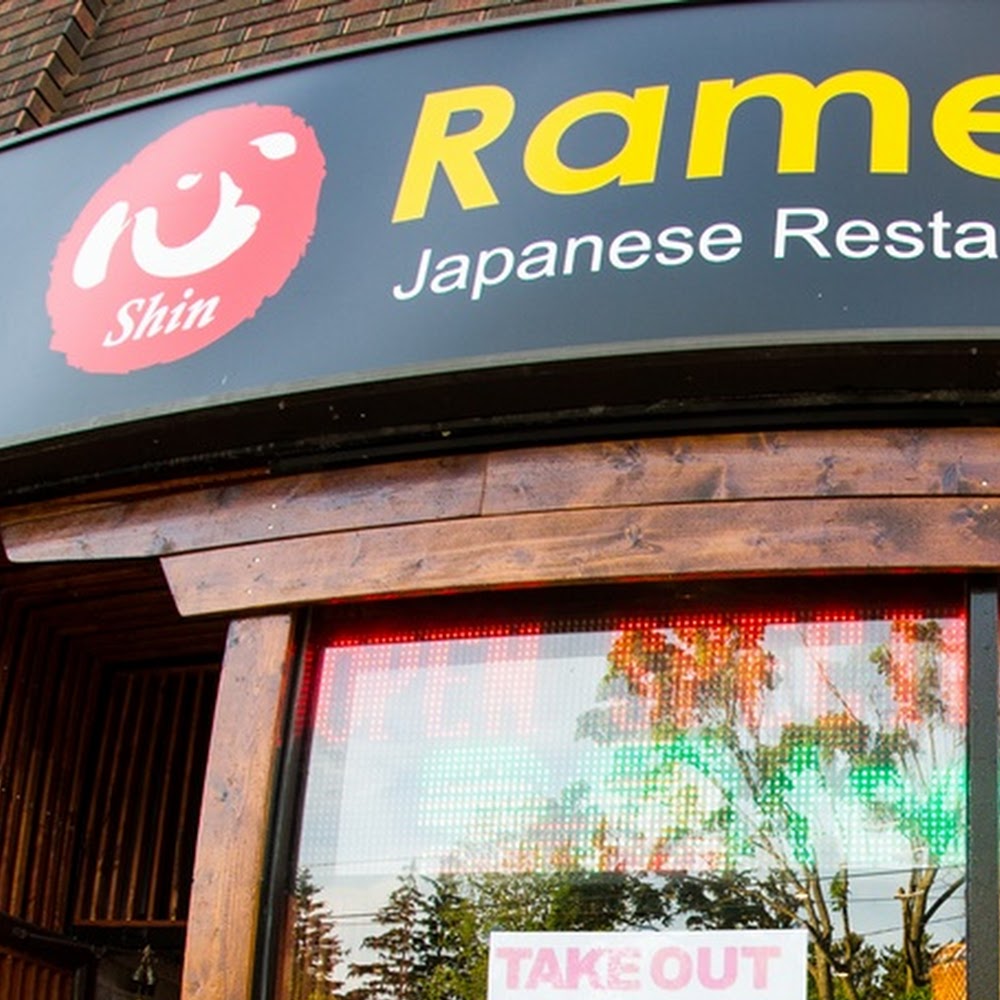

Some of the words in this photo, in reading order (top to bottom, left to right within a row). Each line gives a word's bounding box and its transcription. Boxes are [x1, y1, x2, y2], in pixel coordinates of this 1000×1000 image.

[392, 219, 743, 301] Japanese
[102, 287, 221, 348] Shin
[495, 946, 643, 991] TAKE
[649, 946, 782, 991] OUT
